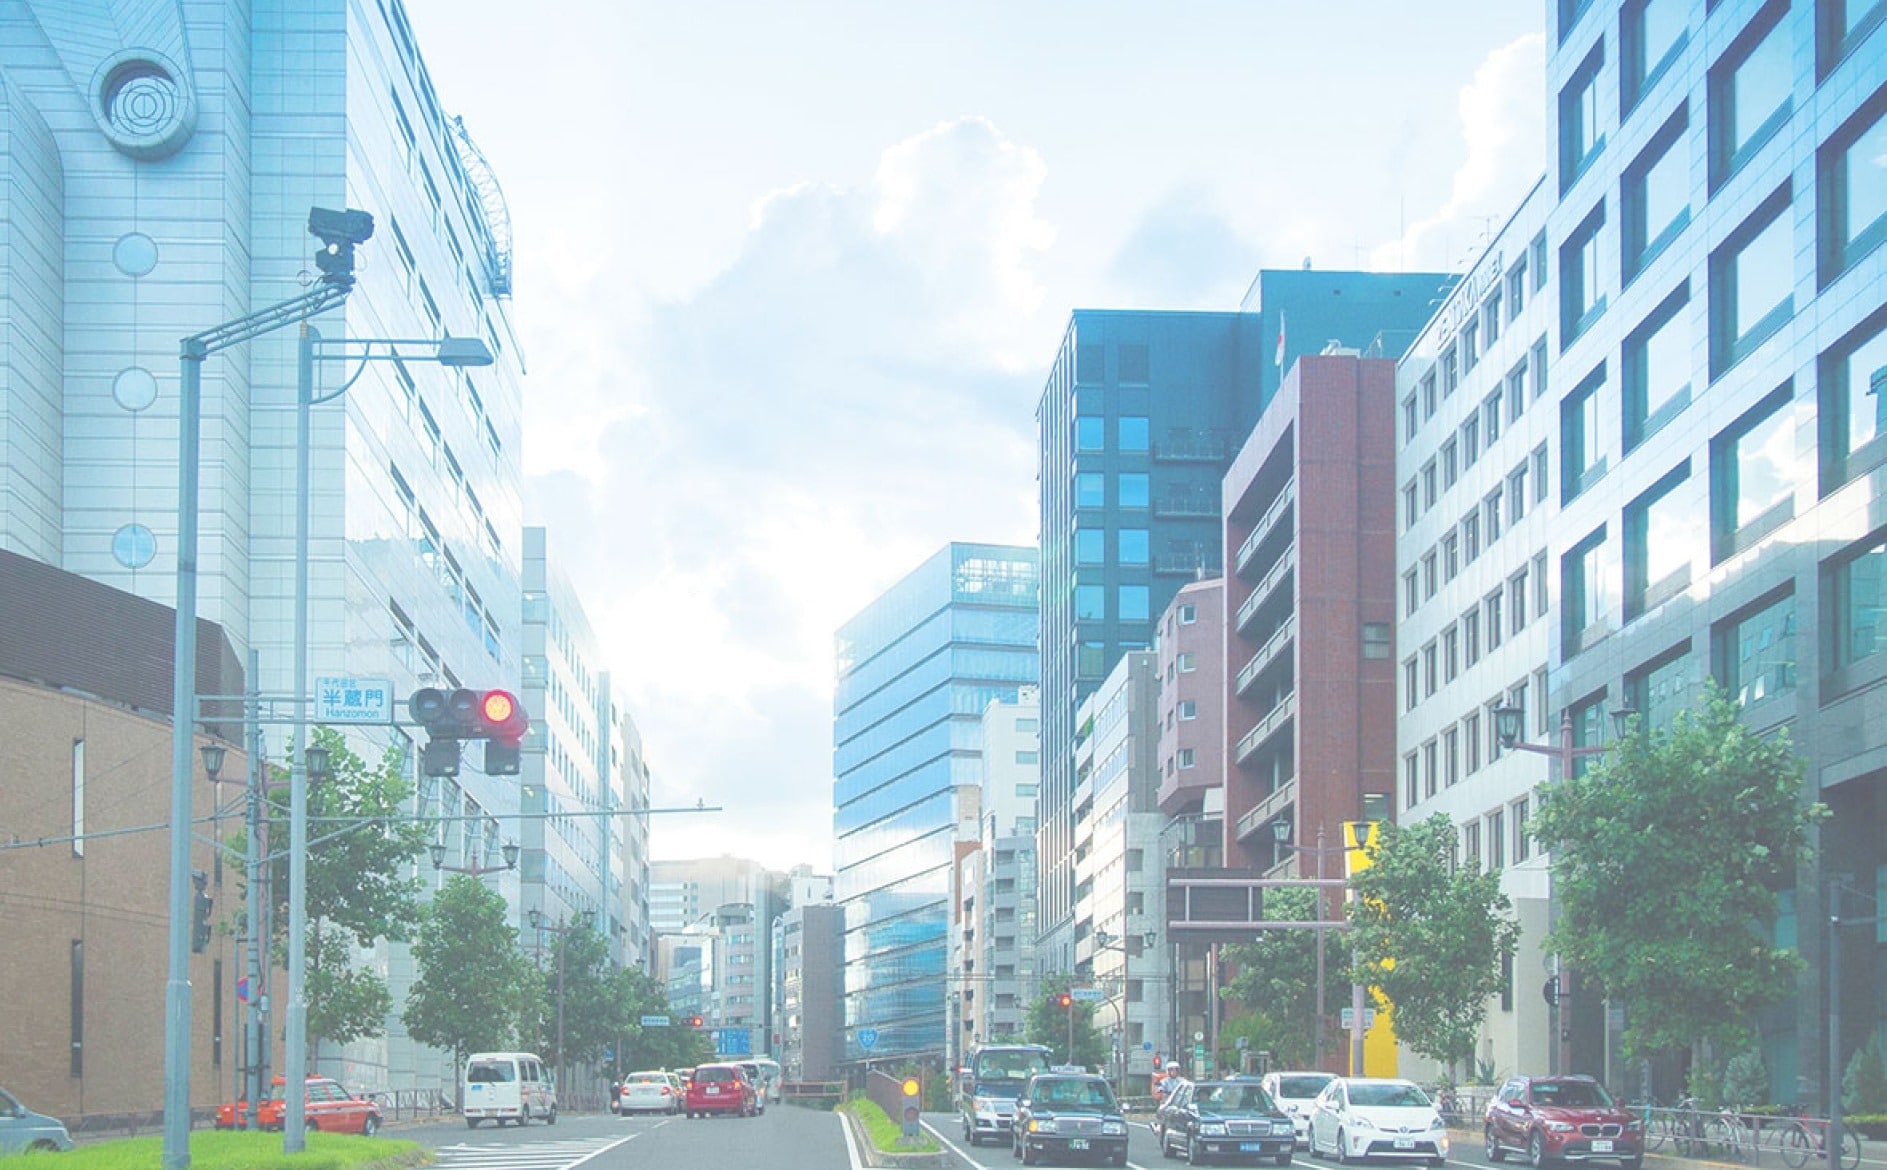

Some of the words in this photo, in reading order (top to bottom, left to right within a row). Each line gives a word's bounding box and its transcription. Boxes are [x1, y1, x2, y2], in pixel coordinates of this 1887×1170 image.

[323, 689, 383, 707] 半蔵門
[325, 707, 379, 718] Hanzomon
